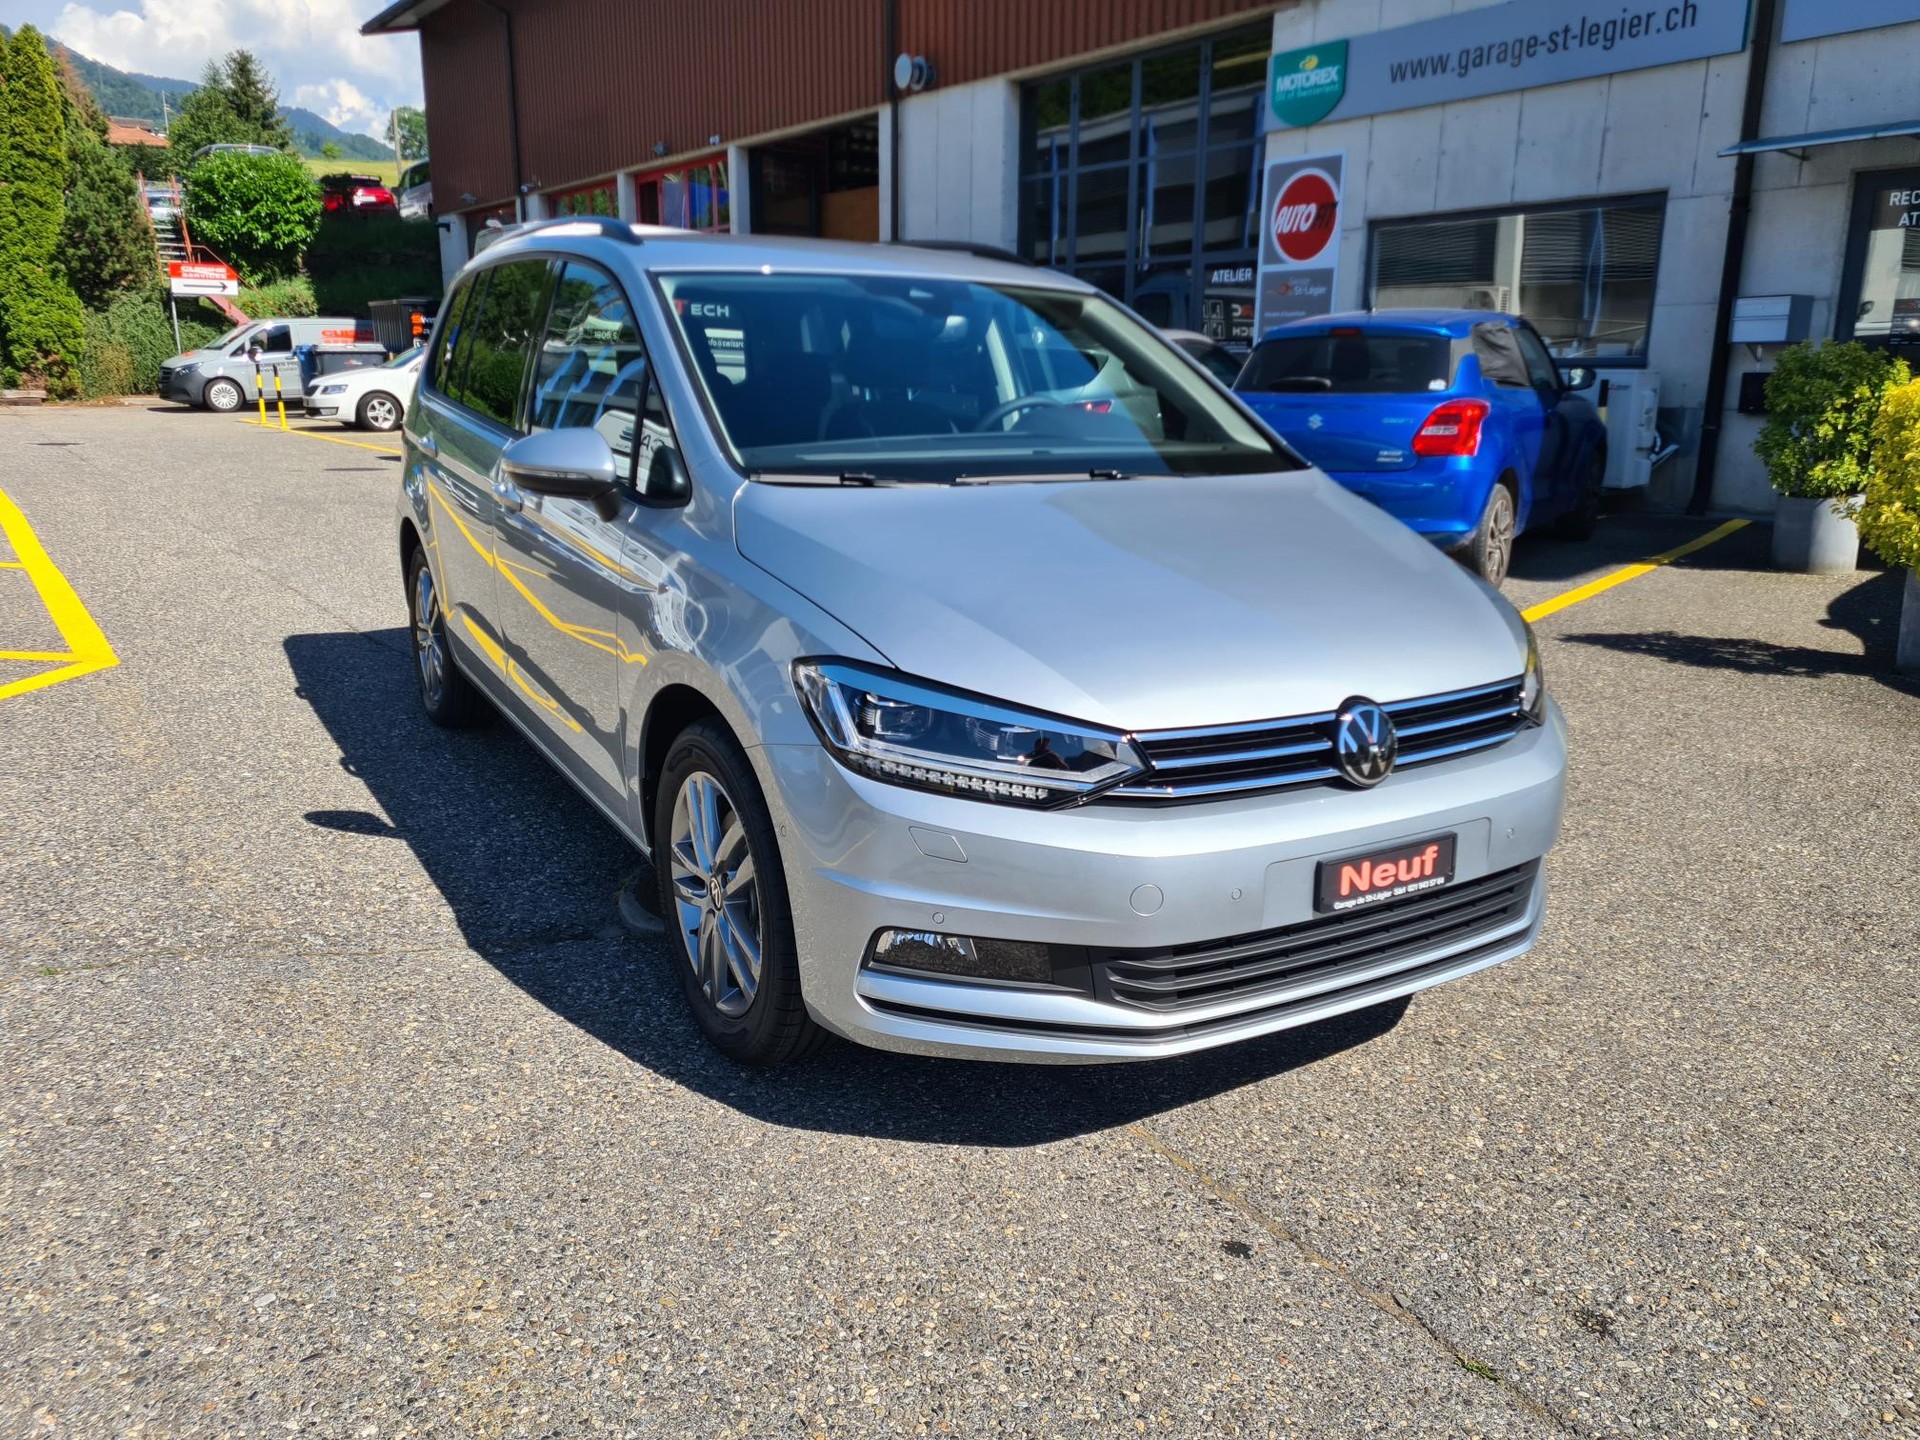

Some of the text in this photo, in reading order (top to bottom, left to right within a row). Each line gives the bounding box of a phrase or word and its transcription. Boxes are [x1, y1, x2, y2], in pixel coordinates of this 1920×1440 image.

[1390, 0, 1698, 84] www.garage-st-legier.ch
[1276, 66, 1340, 92] MOTOREX
[1275, 202, 1317, 234] AUTO
[1211, 267, 1252, 283] ATELIER
[1339, 844, 1439, 897] Neuf
